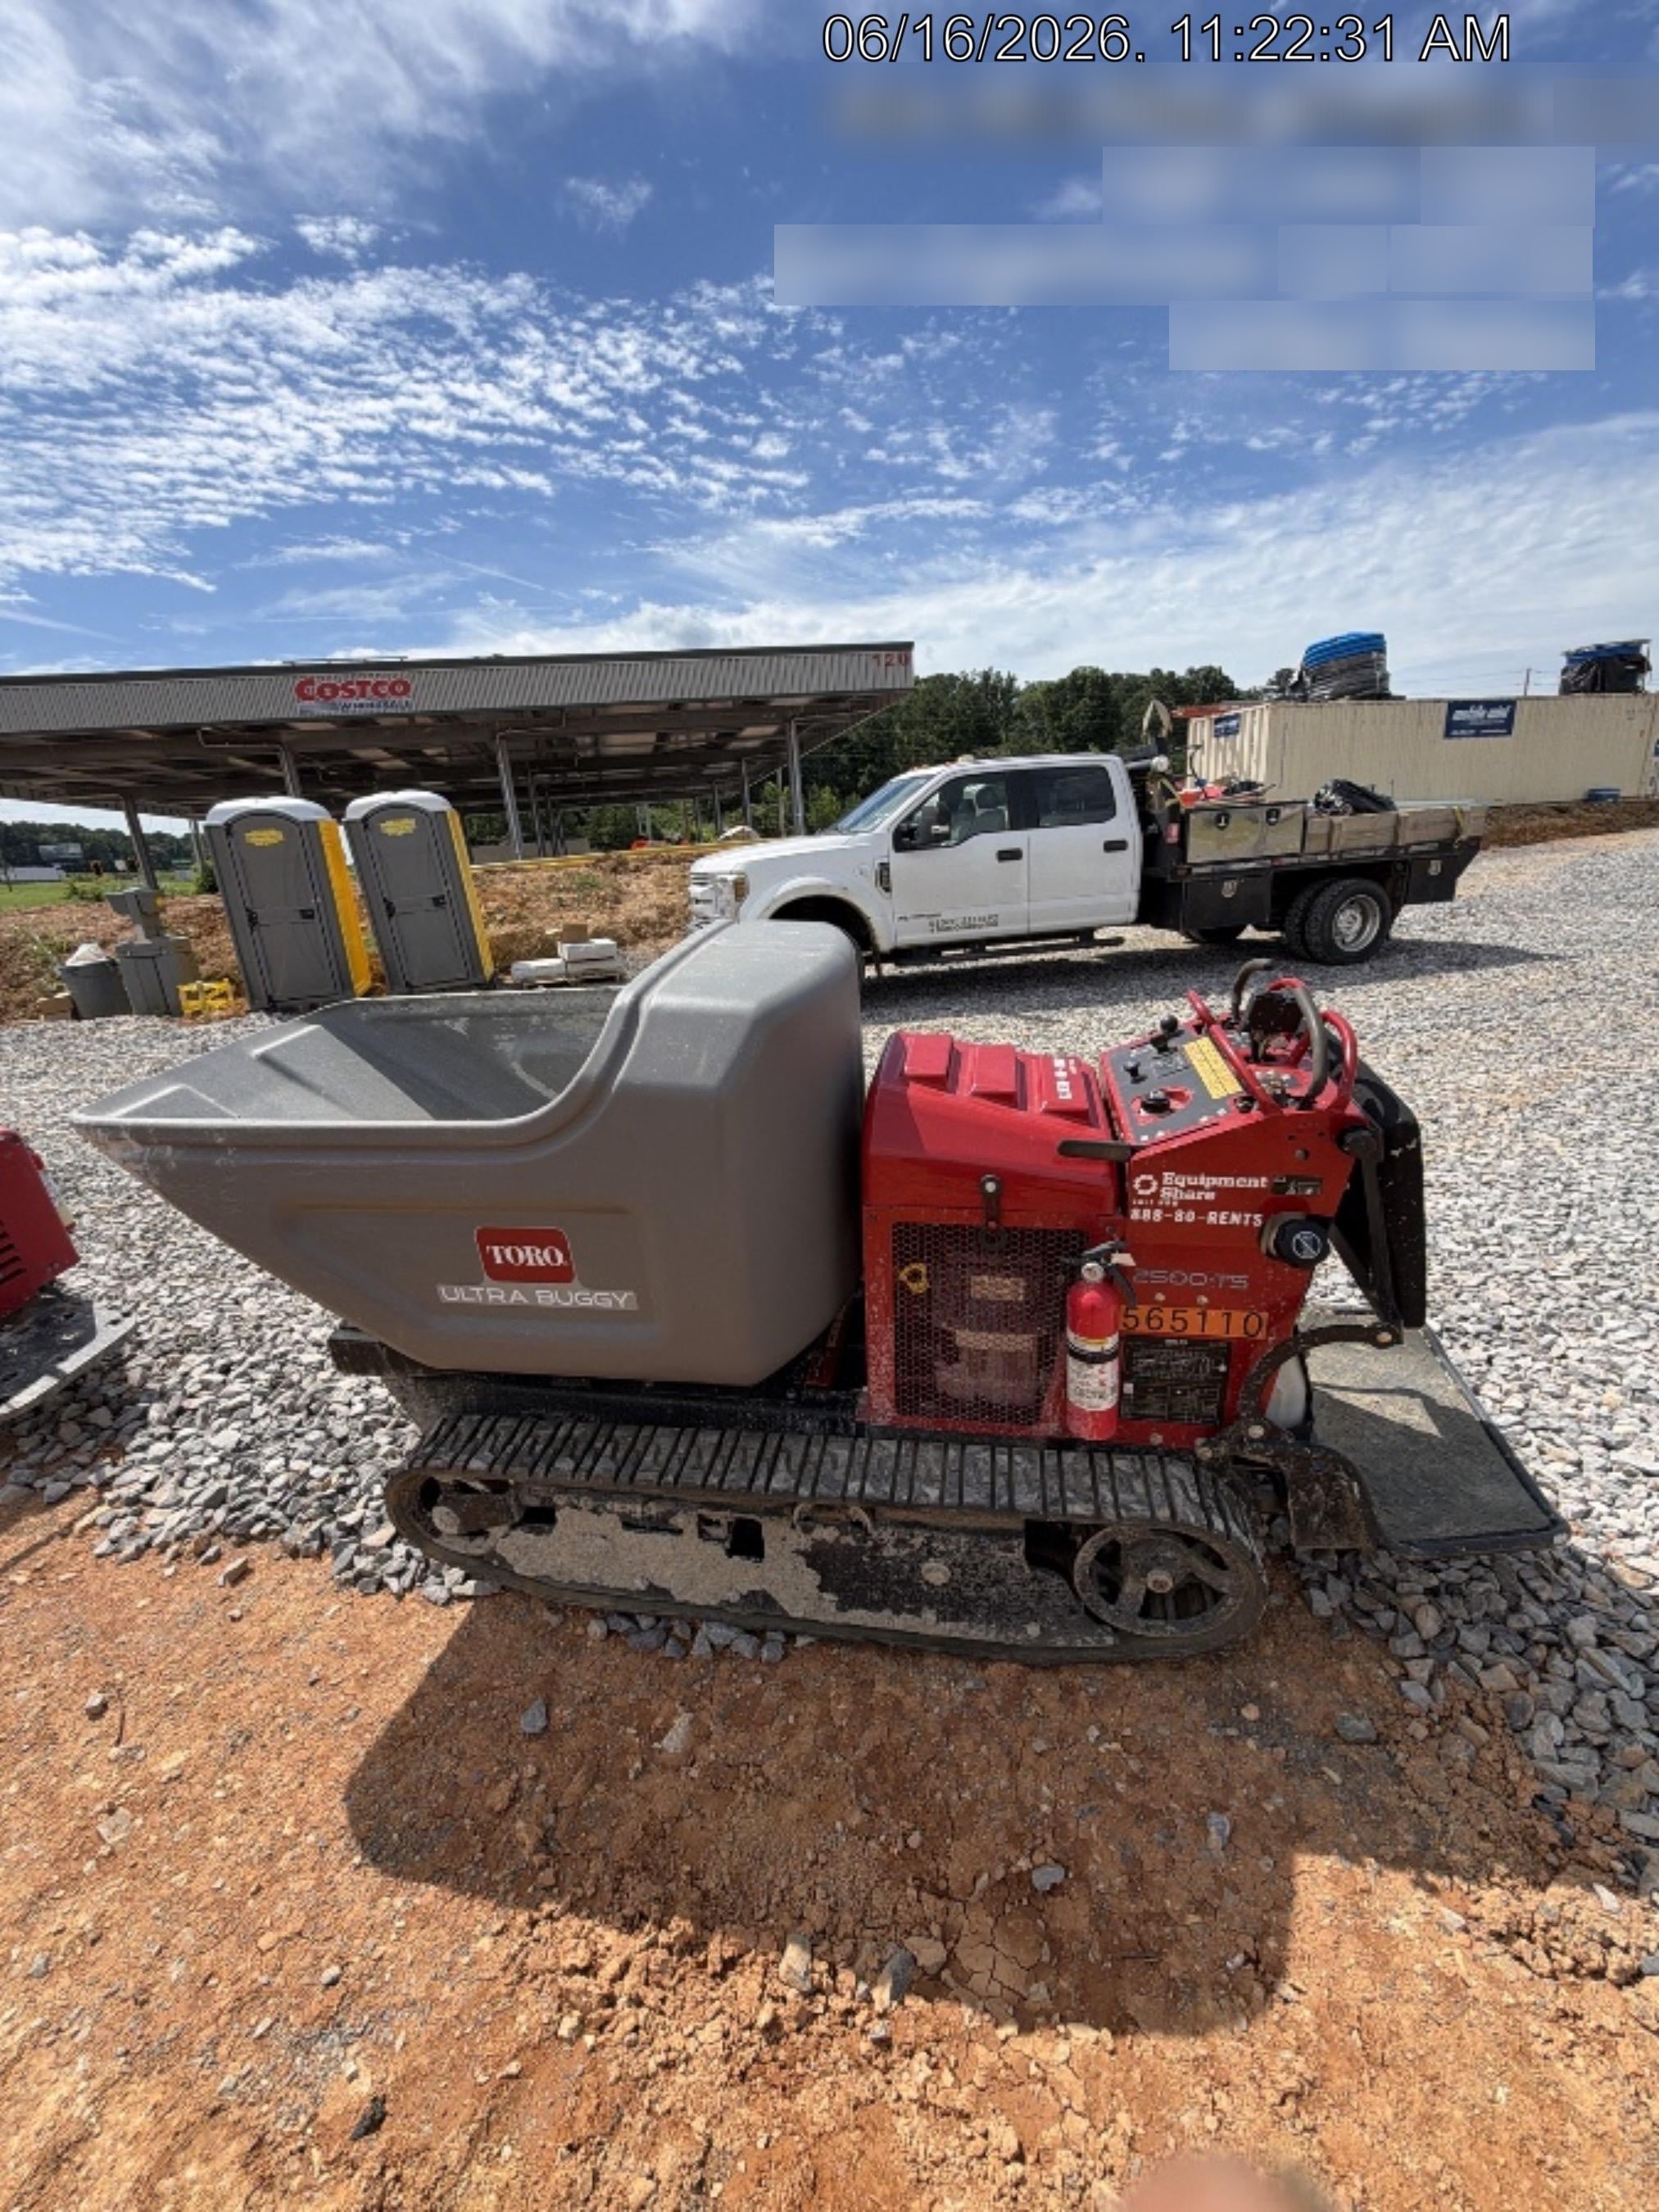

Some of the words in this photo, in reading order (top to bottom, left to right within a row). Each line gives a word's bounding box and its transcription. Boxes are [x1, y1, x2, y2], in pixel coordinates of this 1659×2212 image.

[295, 678, 411, 701] COSTCO
[1162, 1172, 1269, 1189] Equipment
[1160, 1186, 1216, 1201] Share
[1130, 1208, 1264, 1226] 888-80-RENTS
[486, 1244, 565, 1267] TORO
[440, 1287, 528, 1305] ULTRA
[535, 1289, 629, 1308] BUGGY
[1122, 1307, 1264, 1338] 565110
